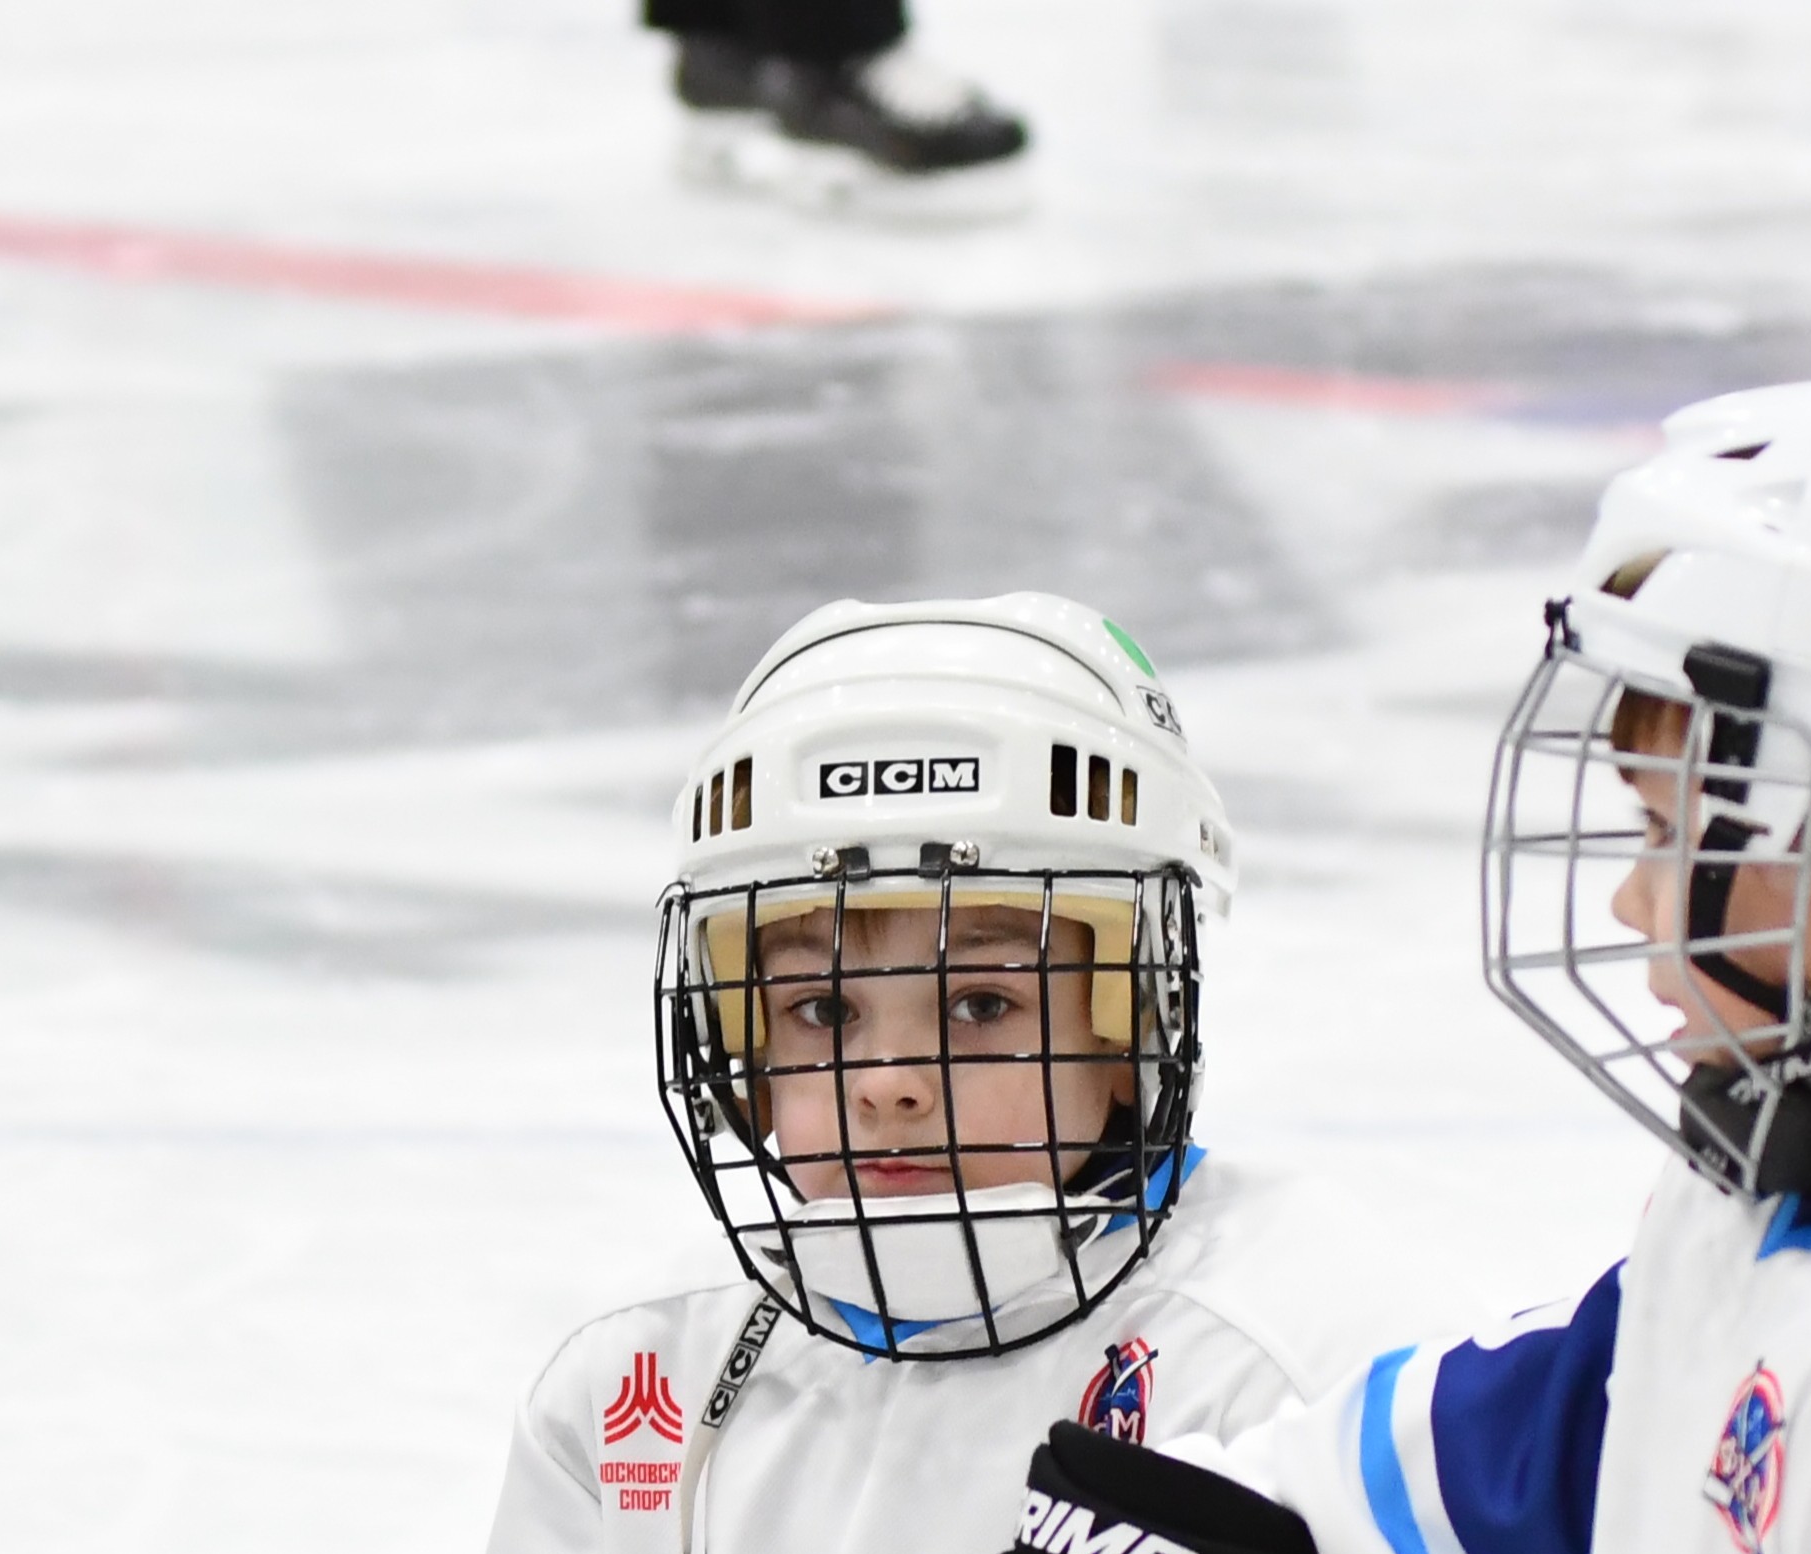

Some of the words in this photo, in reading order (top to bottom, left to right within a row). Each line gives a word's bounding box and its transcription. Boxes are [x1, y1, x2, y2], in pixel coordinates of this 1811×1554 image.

[822, 759, 978, 798] CCM
[708, 1302, 781, 1422] CCM
[600, 1462, 682, 1484] ОСКОВСК
[620, 1489, 673, 1510] СПОРТ
